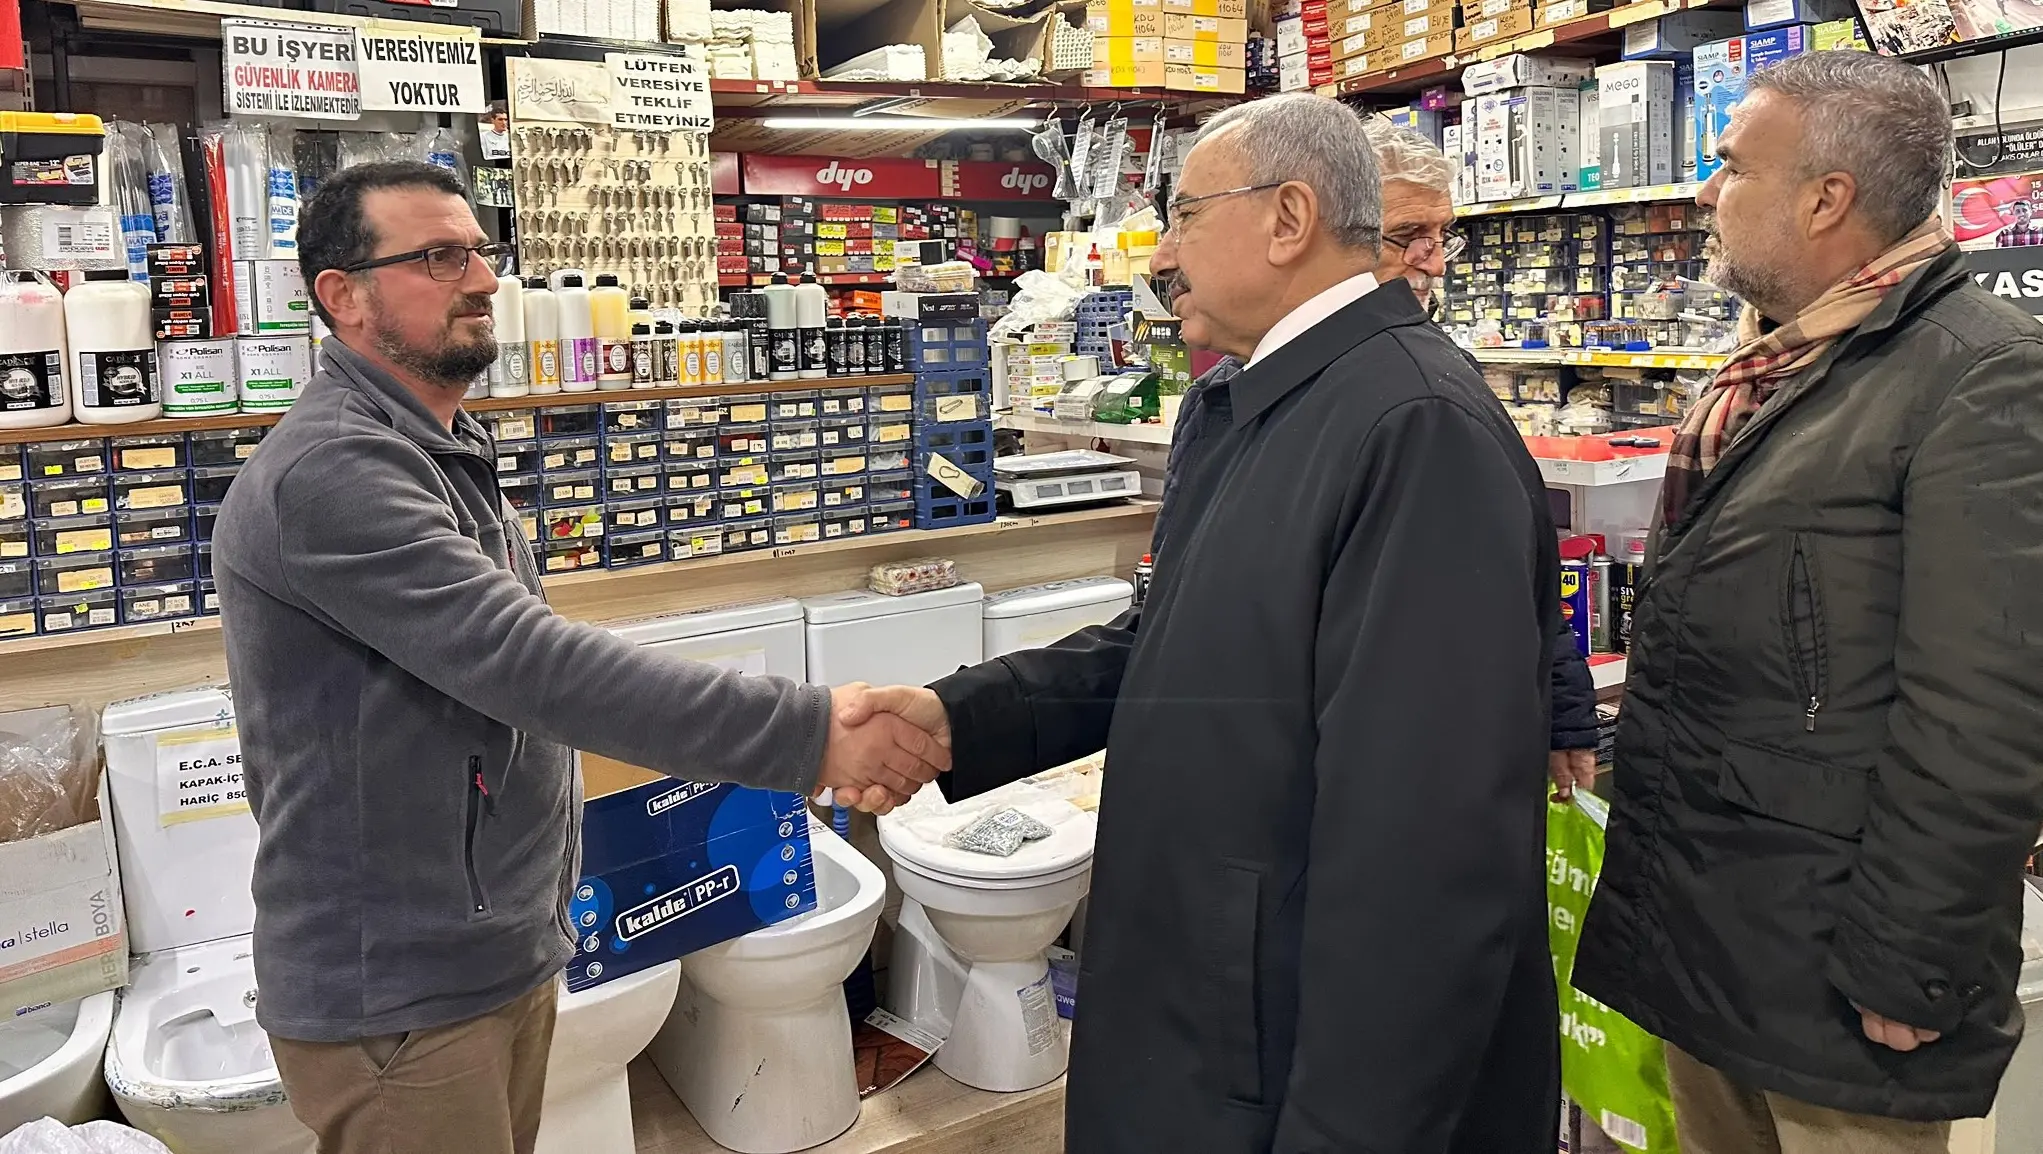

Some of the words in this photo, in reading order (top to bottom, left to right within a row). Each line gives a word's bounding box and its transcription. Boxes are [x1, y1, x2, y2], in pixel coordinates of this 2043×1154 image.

[233, 36, 267, 55] BU
[277, 35, 356, 62] İŞYERİ
[361, 35, 477, 65] VERESİYEMİZ
[624, 60, 693, 74] LÜTFEN
[234, 62, 301, 89] GÜVENLİK
[308, 69, 359, 93] KAMERA
[617, 76, 704, 92] VERESİYE
[236, 87, 272, 110] SİSTEMİ
[274, 90, 289, 111] İLE
[389, 81, 460, 106] YOKTUR
[631, 96, 693, 109] TEKLİF
[615, 112, 711, 128] ETMEYİNİZ
[1977, 136, 1996, 147] ALLAH
[816, 160, 873, 191] dyo
[1001, 167, 1049, 195] dyo
[2031, 180, 2041, 189] 15
[190, 347, 223, 356] Polisan
[258, 344, 291, 353] Polisan
[180, 371, 192, 380] X1
[194, 370, 214, 379] ALL
[250, 367, 261, 376] X1
[263, 366, 282, 375] ALL
[1562, 574, 1576, 586] 40
[179, 757, 222, 771] E.C.A.
[180, 793, 220, 806] HARİÇ
[652, 787, 689, 812] kalde
[625, 891, 688, 934] kalde
[695, 875, 732, 903] PP-r
[90, 889, 110, 937] BOYA
[25, 920, 70, 944] stella
